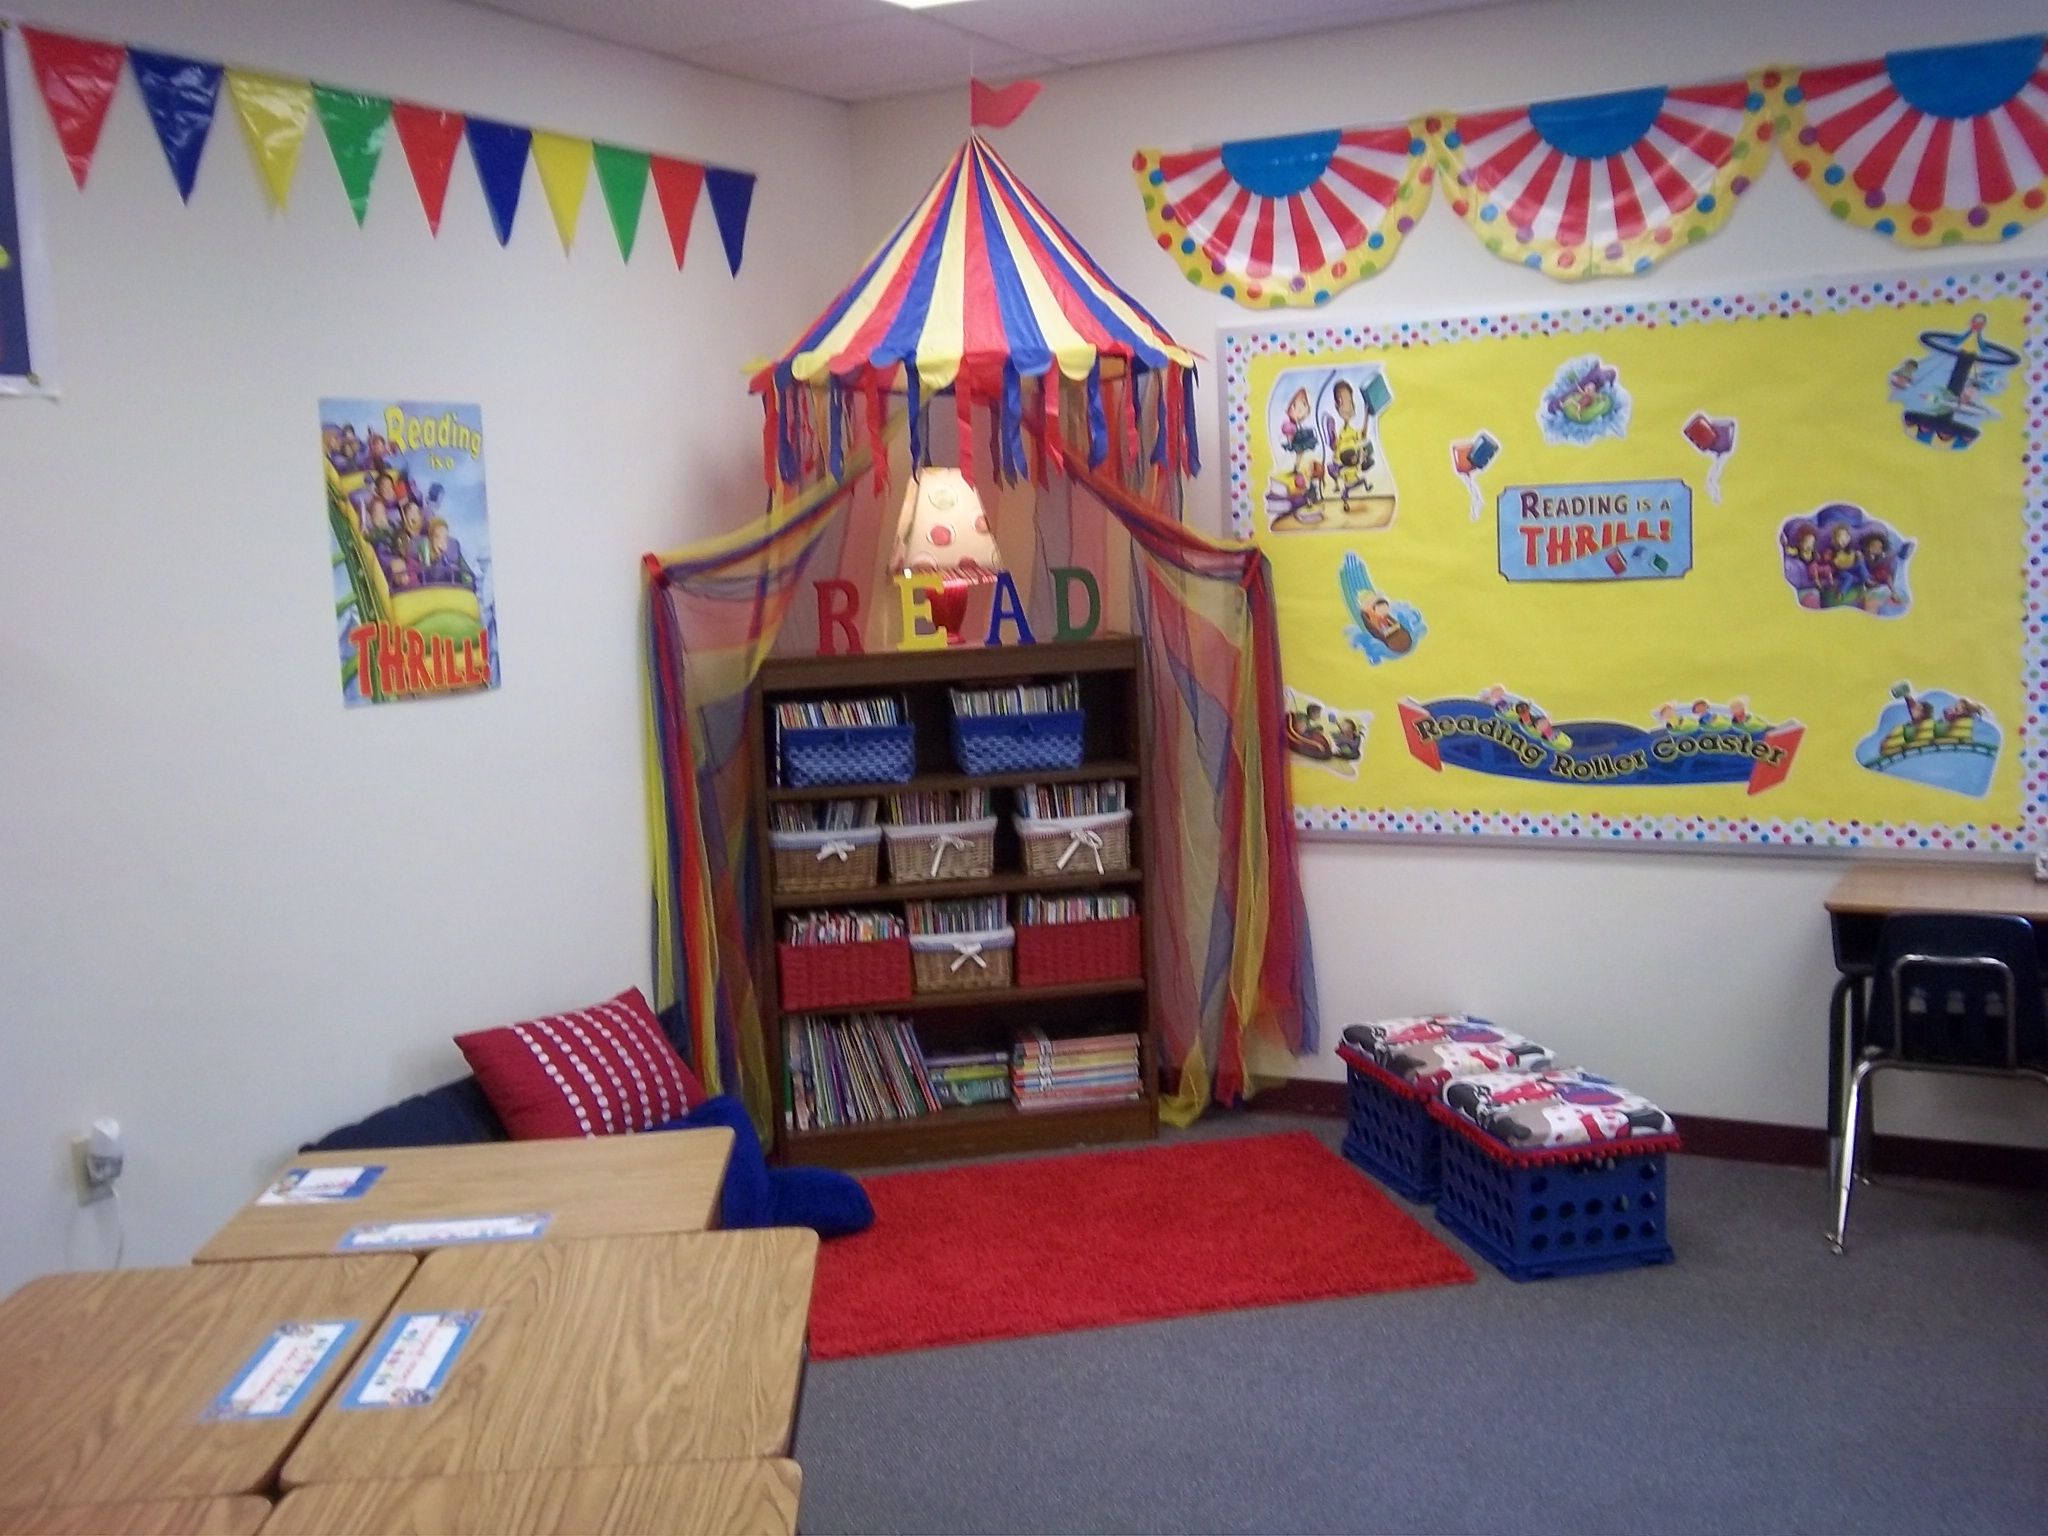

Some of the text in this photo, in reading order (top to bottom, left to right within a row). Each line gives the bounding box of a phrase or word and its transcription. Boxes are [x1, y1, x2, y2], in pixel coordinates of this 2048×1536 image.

[383, 406, 483, 461] Reading
[428, 454, 443, 470] is
[1519, 519, 1672, 567] THRILL!
[350, 621, 492, 699] THRILL!
[1414, 714, 1788, 781] Reading Roller Coaster
